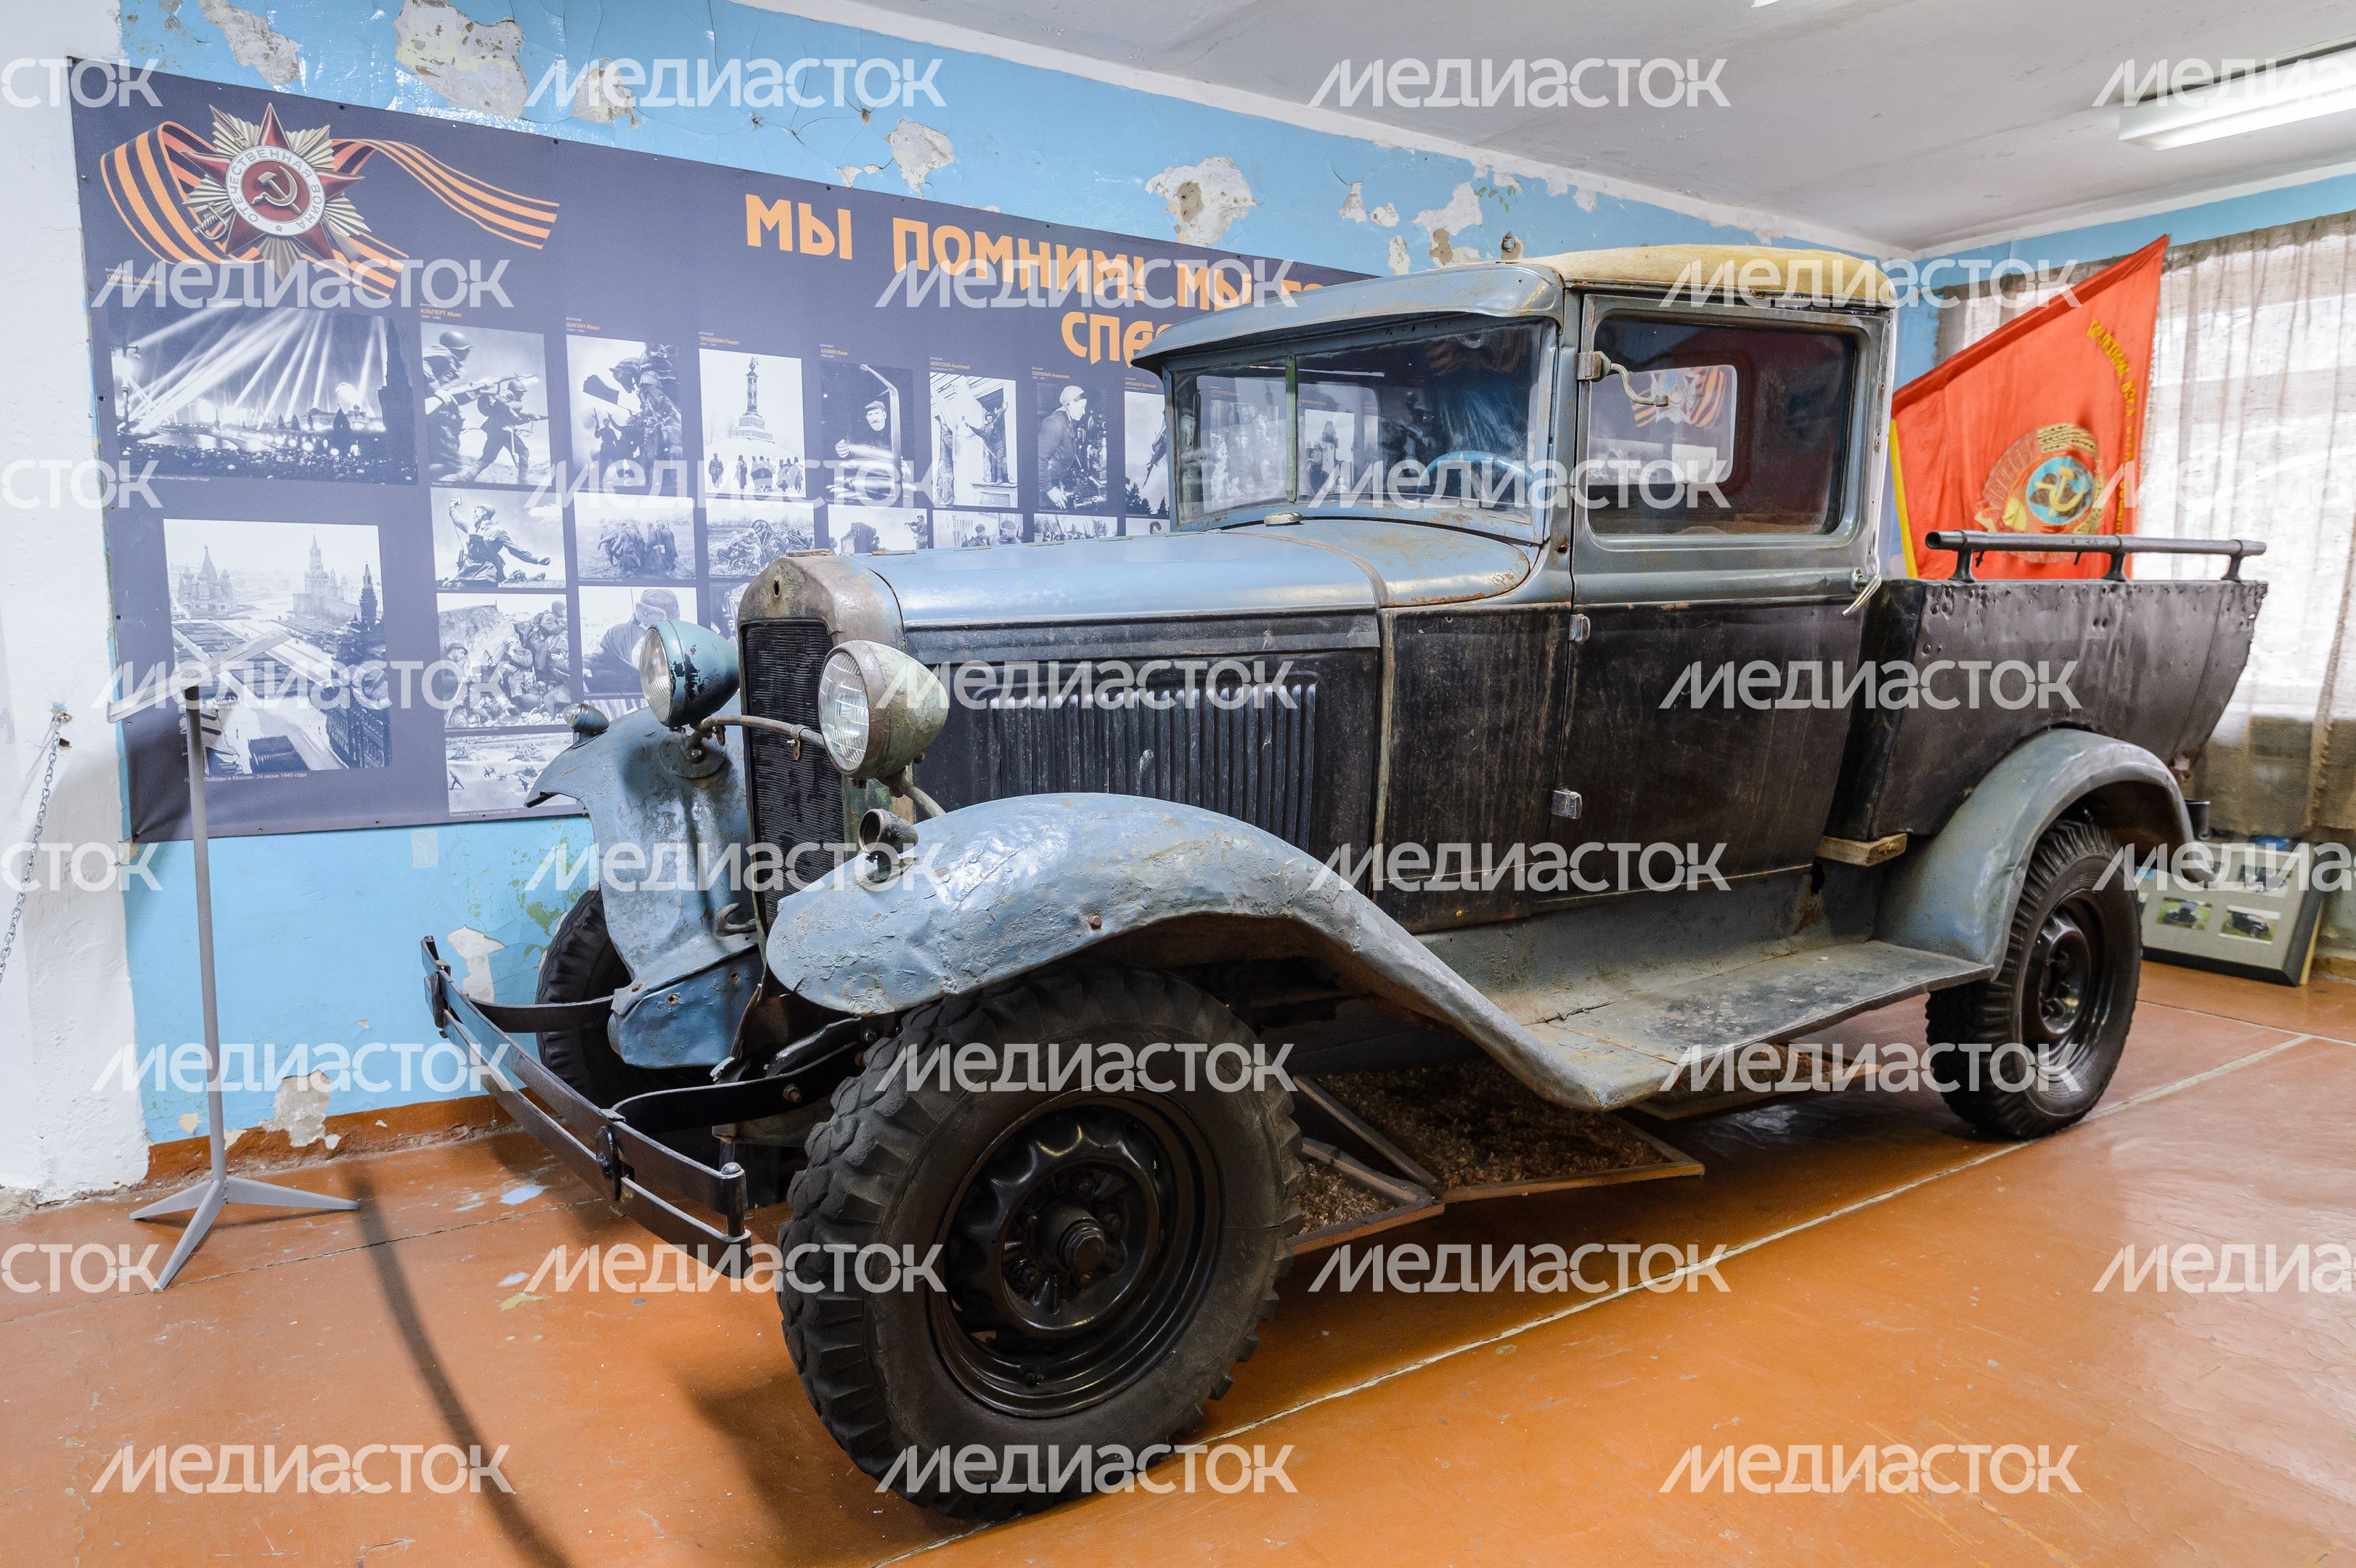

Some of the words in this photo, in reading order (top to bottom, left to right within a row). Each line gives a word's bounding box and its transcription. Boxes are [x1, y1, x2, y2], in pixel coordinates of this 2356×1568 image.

[229, 148, 312, 222] ОТЕЧЕСТВЕННАЯ
[746, 194, 852, 260] МЫ
[893, 218, 1144, 302] ПОМНИМ!
[1177, 262, 1252, 311] МЫ
[1061, 311, 1173, 368] СПА
